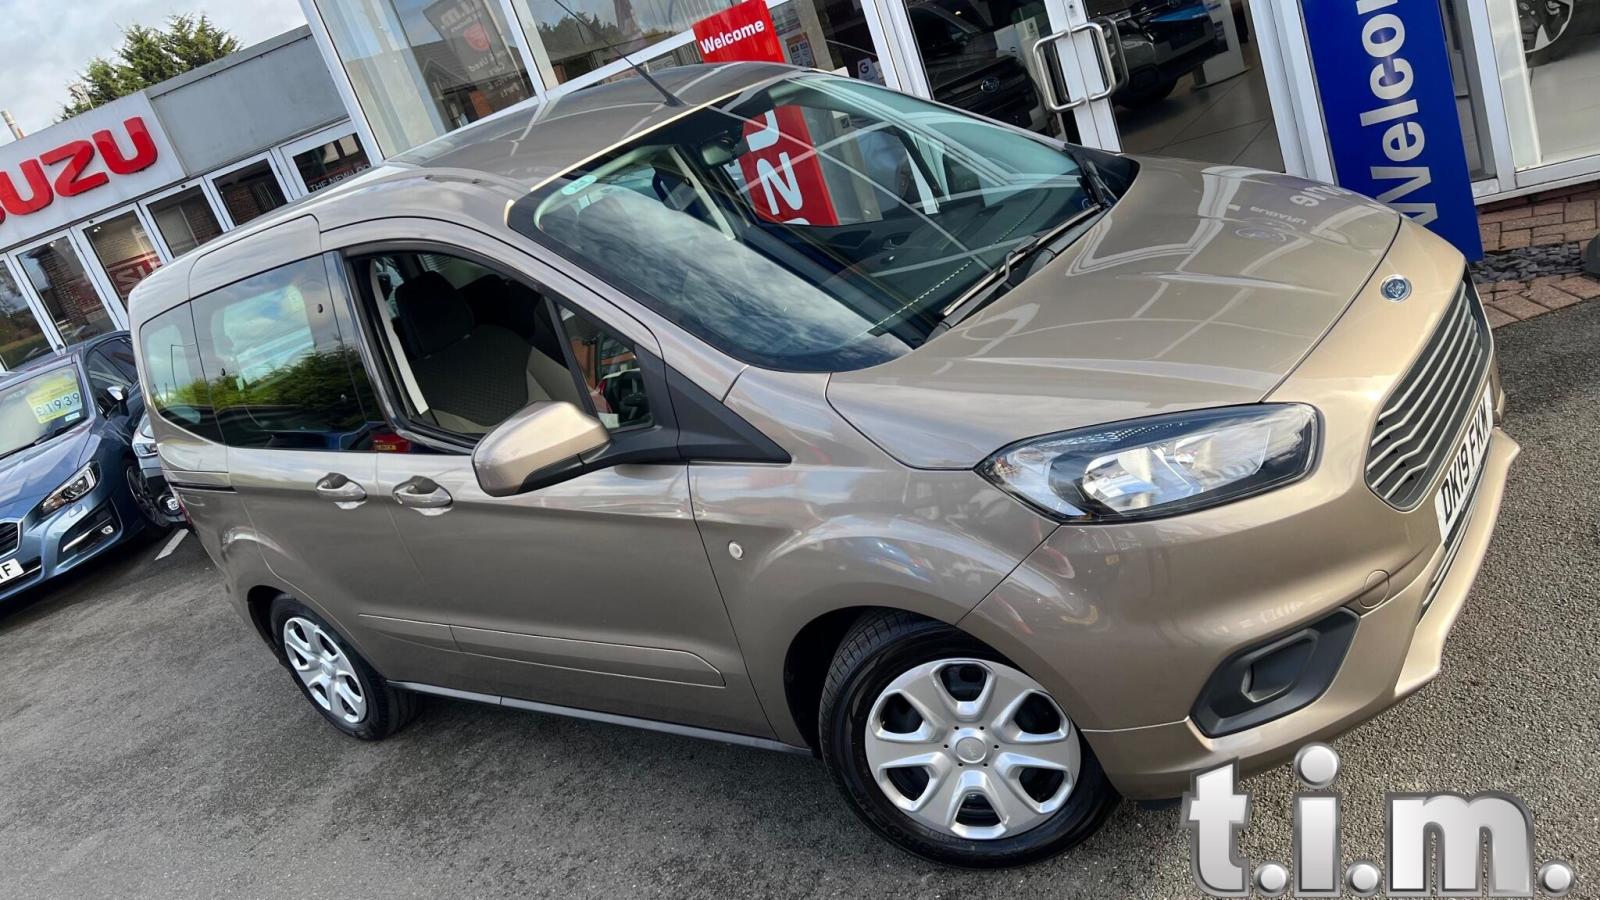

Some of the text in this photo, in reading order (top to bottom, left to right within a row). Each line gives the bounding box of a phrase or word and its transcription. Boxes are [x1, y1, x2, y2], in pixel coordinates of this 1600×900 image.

[700, 19, 765, 54] Welcome
[0, 116, 158, 224] UZU
[1440, 456, 1470, 526] DK19
